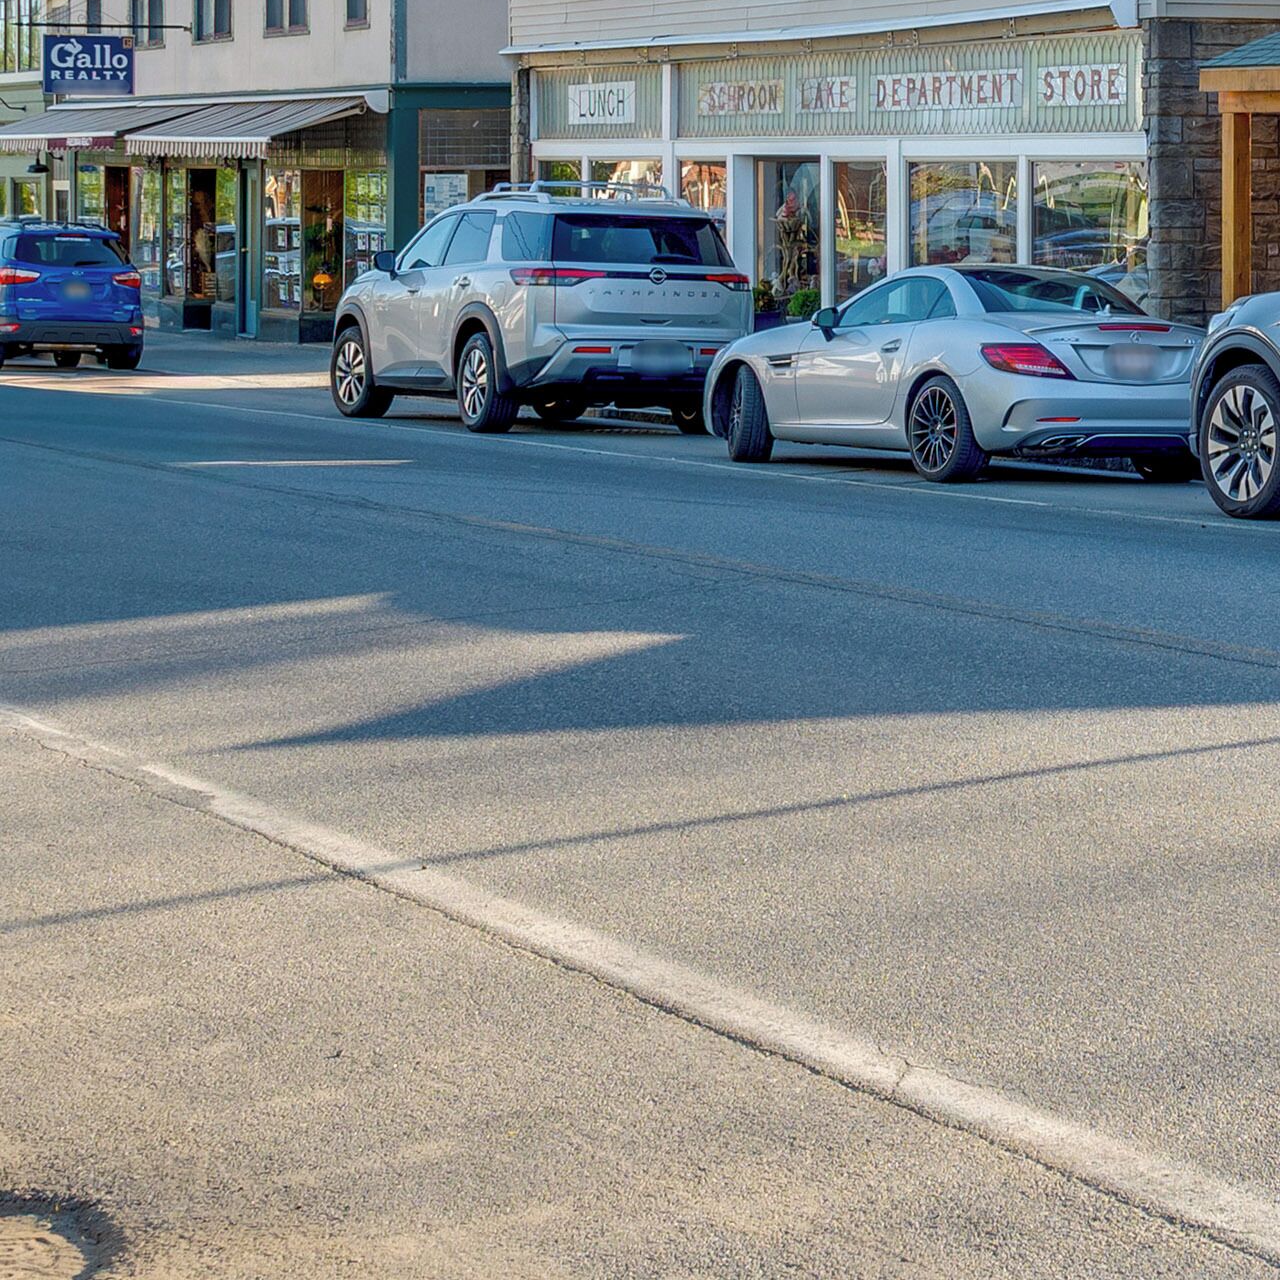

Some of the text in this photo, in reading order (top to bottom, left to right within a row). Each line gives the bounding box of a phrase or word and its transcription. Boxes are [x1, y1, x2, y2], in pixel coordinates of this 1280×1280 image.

[50, 39, 128, 69] Gallo
[50, 70, 127, 80] REALTY
[578, 88, 626, 118] LUNCH
[708, 69, 1120, 113] SCHROON LAKE DEPARTMENT STORE
[589, 289, 721, 298] PATHFINDER
